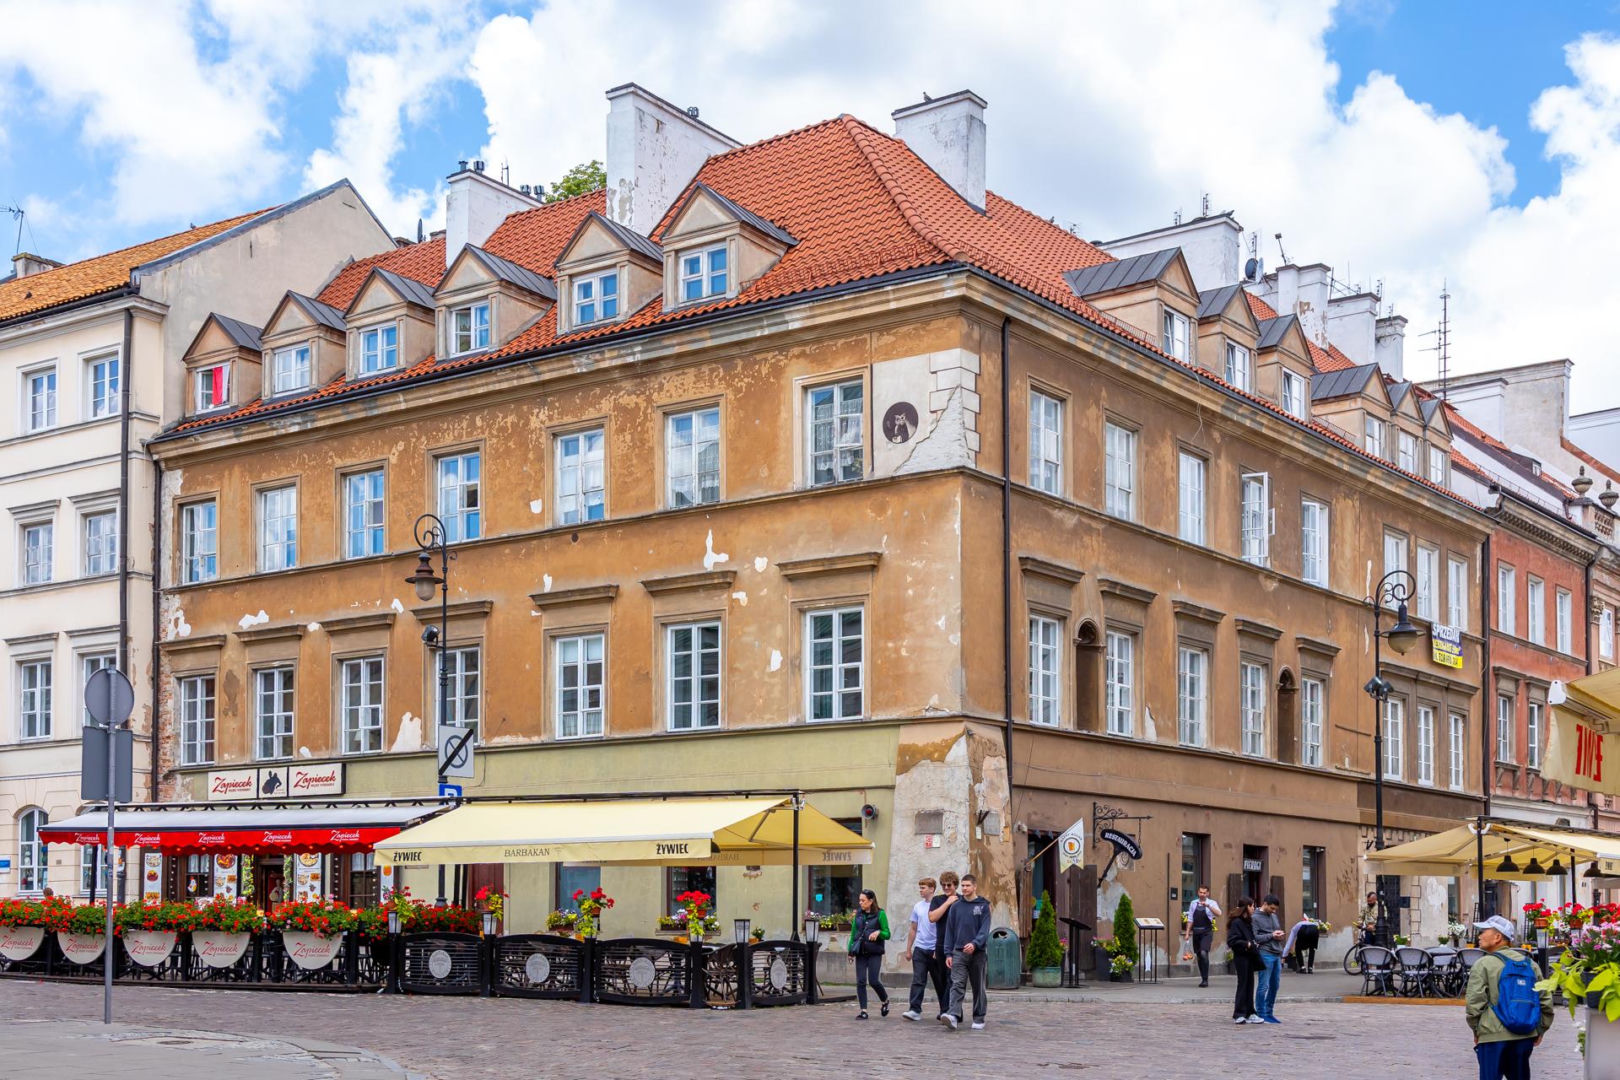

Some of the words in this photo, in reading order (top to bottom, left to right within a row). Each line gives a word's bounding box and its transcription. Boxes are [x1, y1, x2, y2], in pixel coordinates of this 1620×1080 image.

[212, 776, 252, 794] Zapiecek
[293, 770, 336, 789] Zapiecek
[134, 833, 160, 844] Zapiecek
[199, 832, 225, 844] Zapiecek
[262, 831, 292, 843] Zapiecek
[330, 830, 360, 842] Zapiecek
[656, 843, 689, 855] ŻYWIEC
[1104, 832, 1137, 857] RESTAURACJA
[393, 851, 422, 862] ŻYWIEC
[504, 848, 550, 857] BARBAKAN
[0, 935, 33, 950] Zapiecek
[65, 938, 99, 953] Zapiecek
[131, 940, 166, 955] Zapiecek
[202, 941, 238, 957] Zapiecek
[293, 942, 331, 958] Zapiecek
